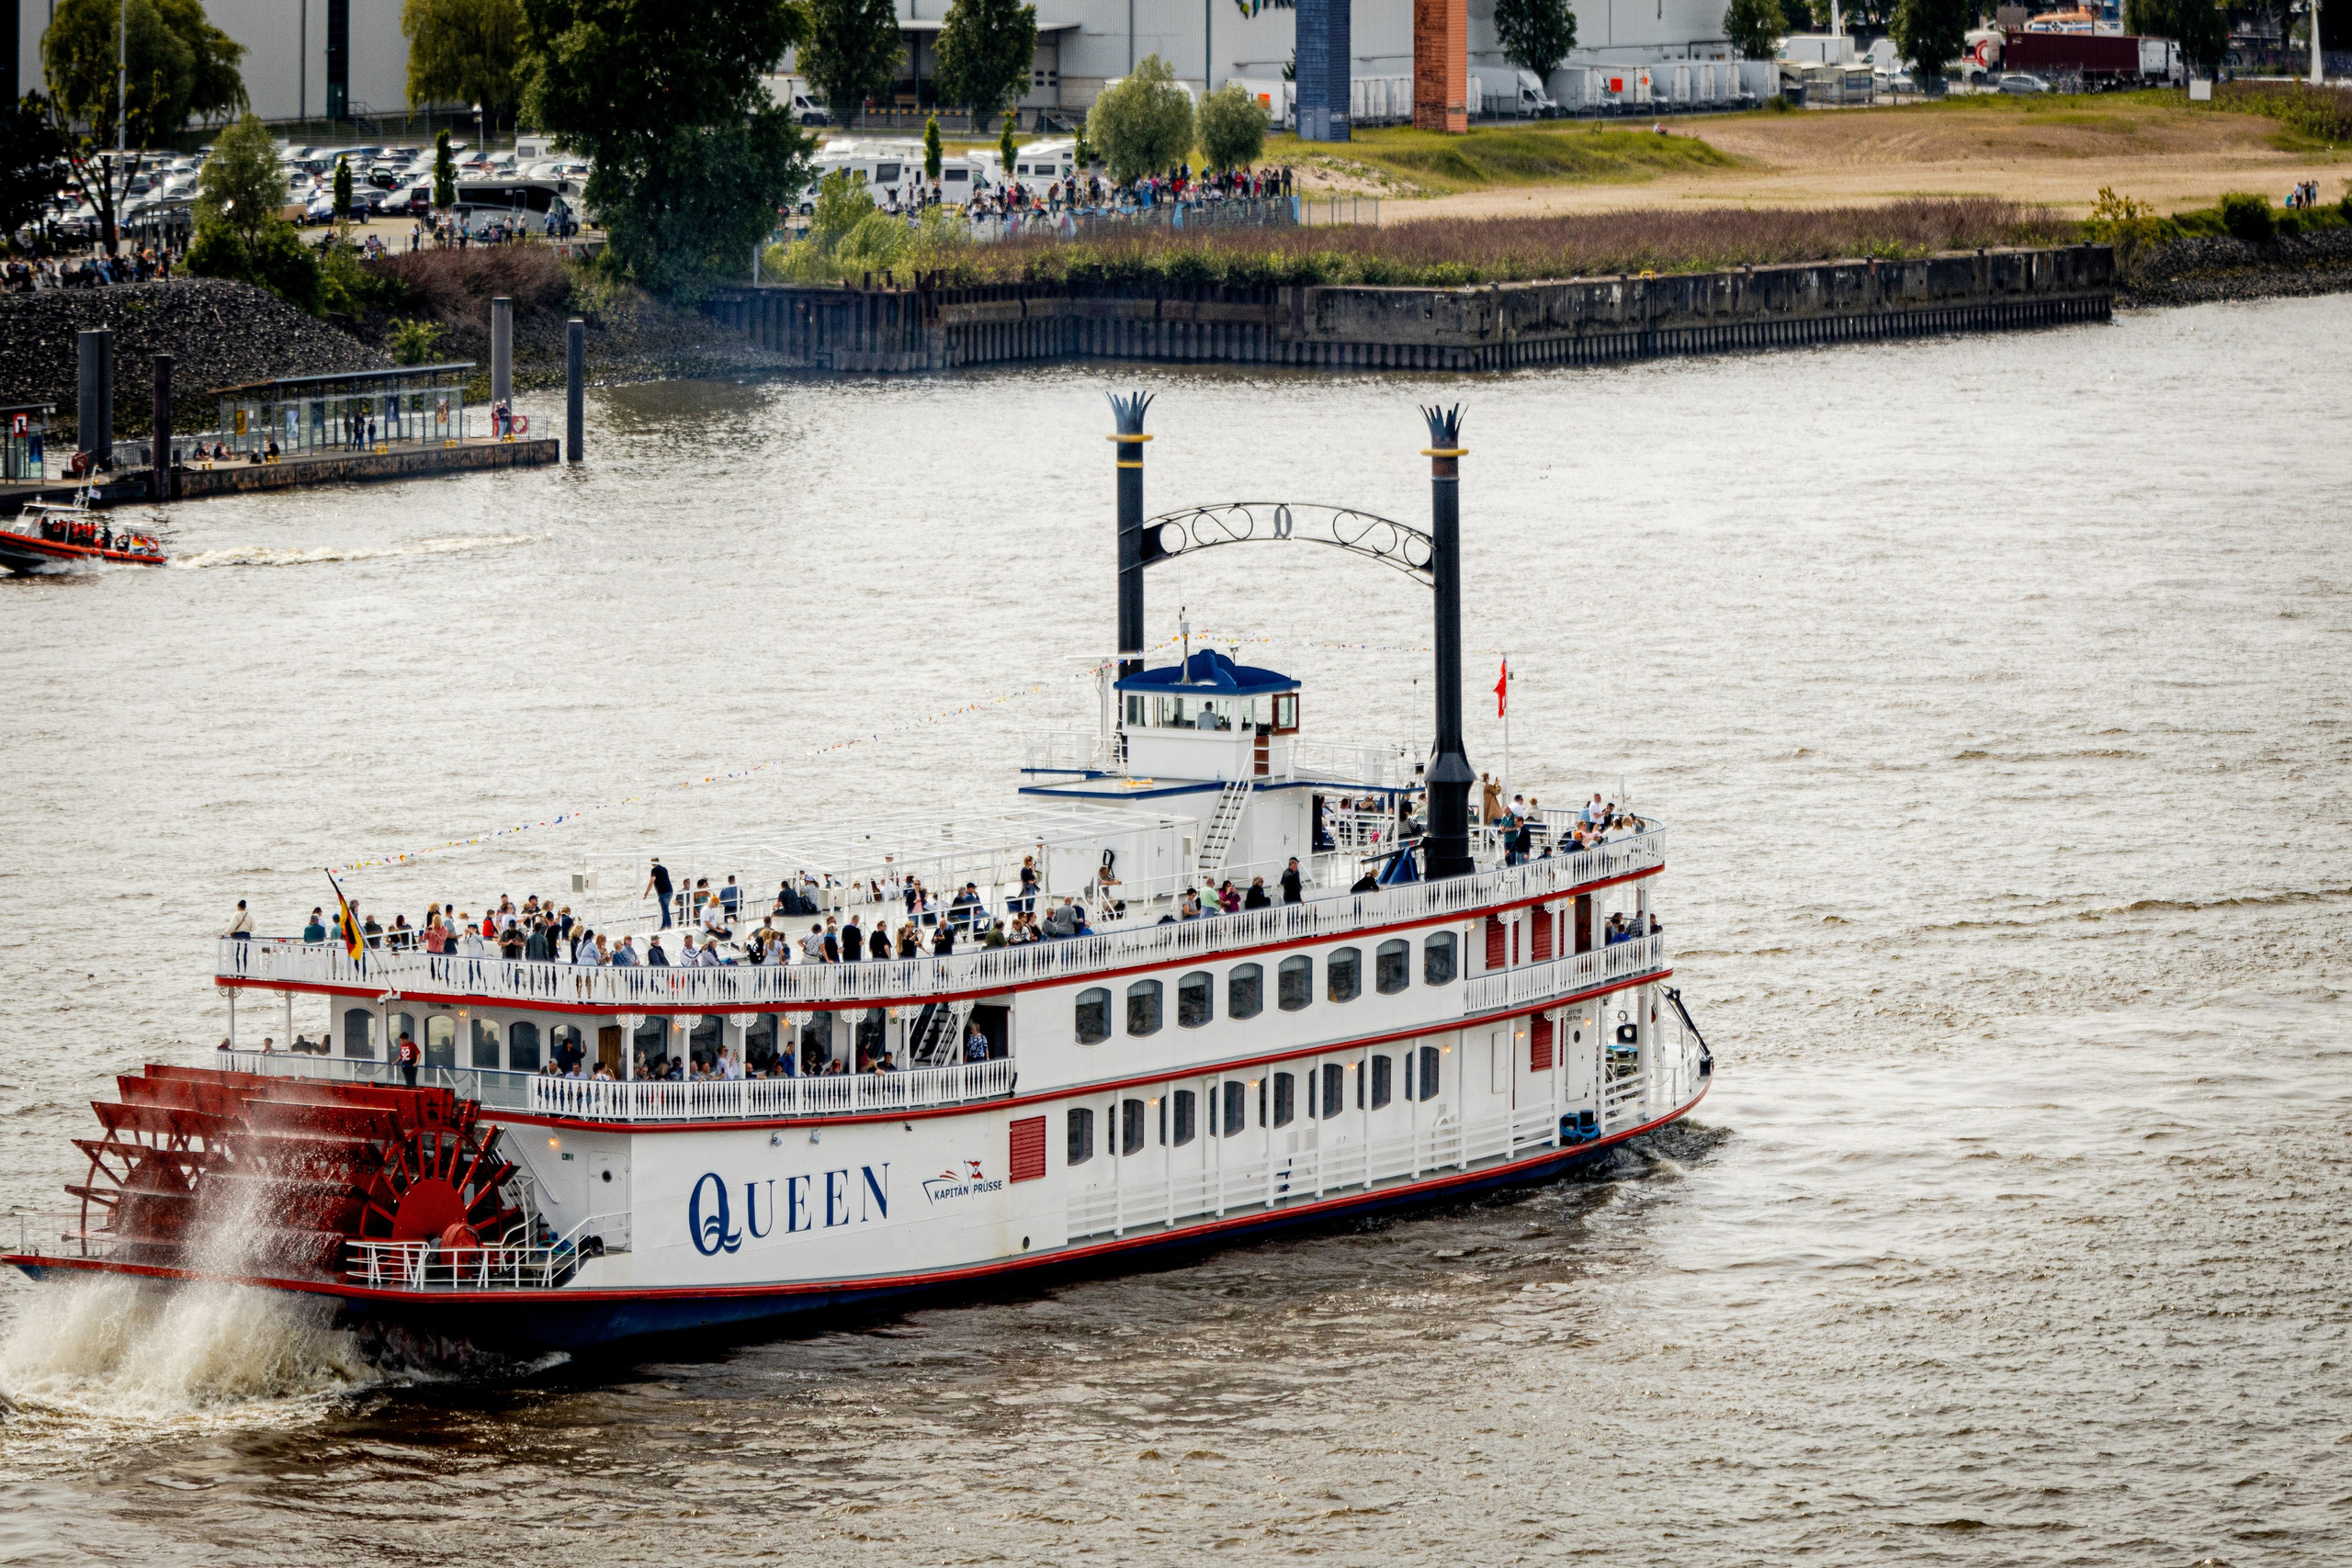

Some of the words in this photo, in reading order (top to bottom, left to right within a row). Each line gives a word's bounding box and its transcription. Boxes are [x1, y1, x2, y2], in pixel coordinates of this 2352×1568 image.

[689, 1162, 890, 1257] QUEEN
[934, 1185, 969, 1201] KAPITÄN
[973, 1180, 1002, 1194] PRÜSSE
